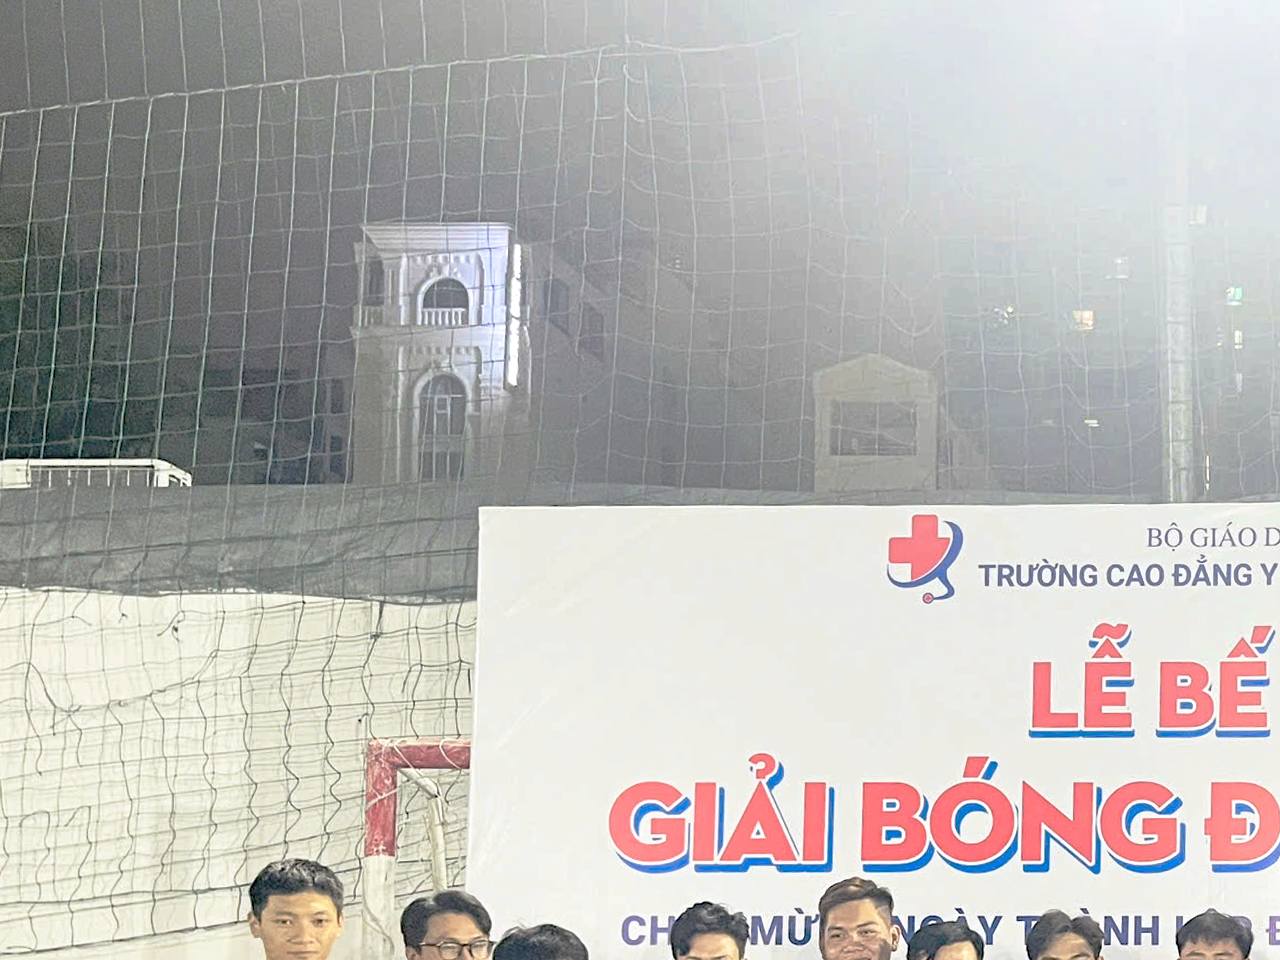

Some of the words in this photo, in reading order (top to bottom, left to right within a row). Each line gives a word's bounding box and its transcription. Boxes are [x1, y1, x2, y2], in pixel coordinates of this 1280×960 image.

[1147, 522, 1183, 551] BỘ
[1190, 522, 1257, 547] GIÁO
[978, 559, 1097, 587] TRƯỜNG
[1107, 563, 1164, 587] CAO
[1172, 554, 1252, 587] ĐẲNG
[1260, 563, 1278, 586] Y
[1028, 623, 1135, 738] LỄ
[1156, 625, 1275, 738] BẾ
[609, 753, 835, 874] GIẢI
[861, 756, 1186, 874] BÓNG
[621, 915, 676, 946] CH
[750, 908, 819, 946] MỪ
